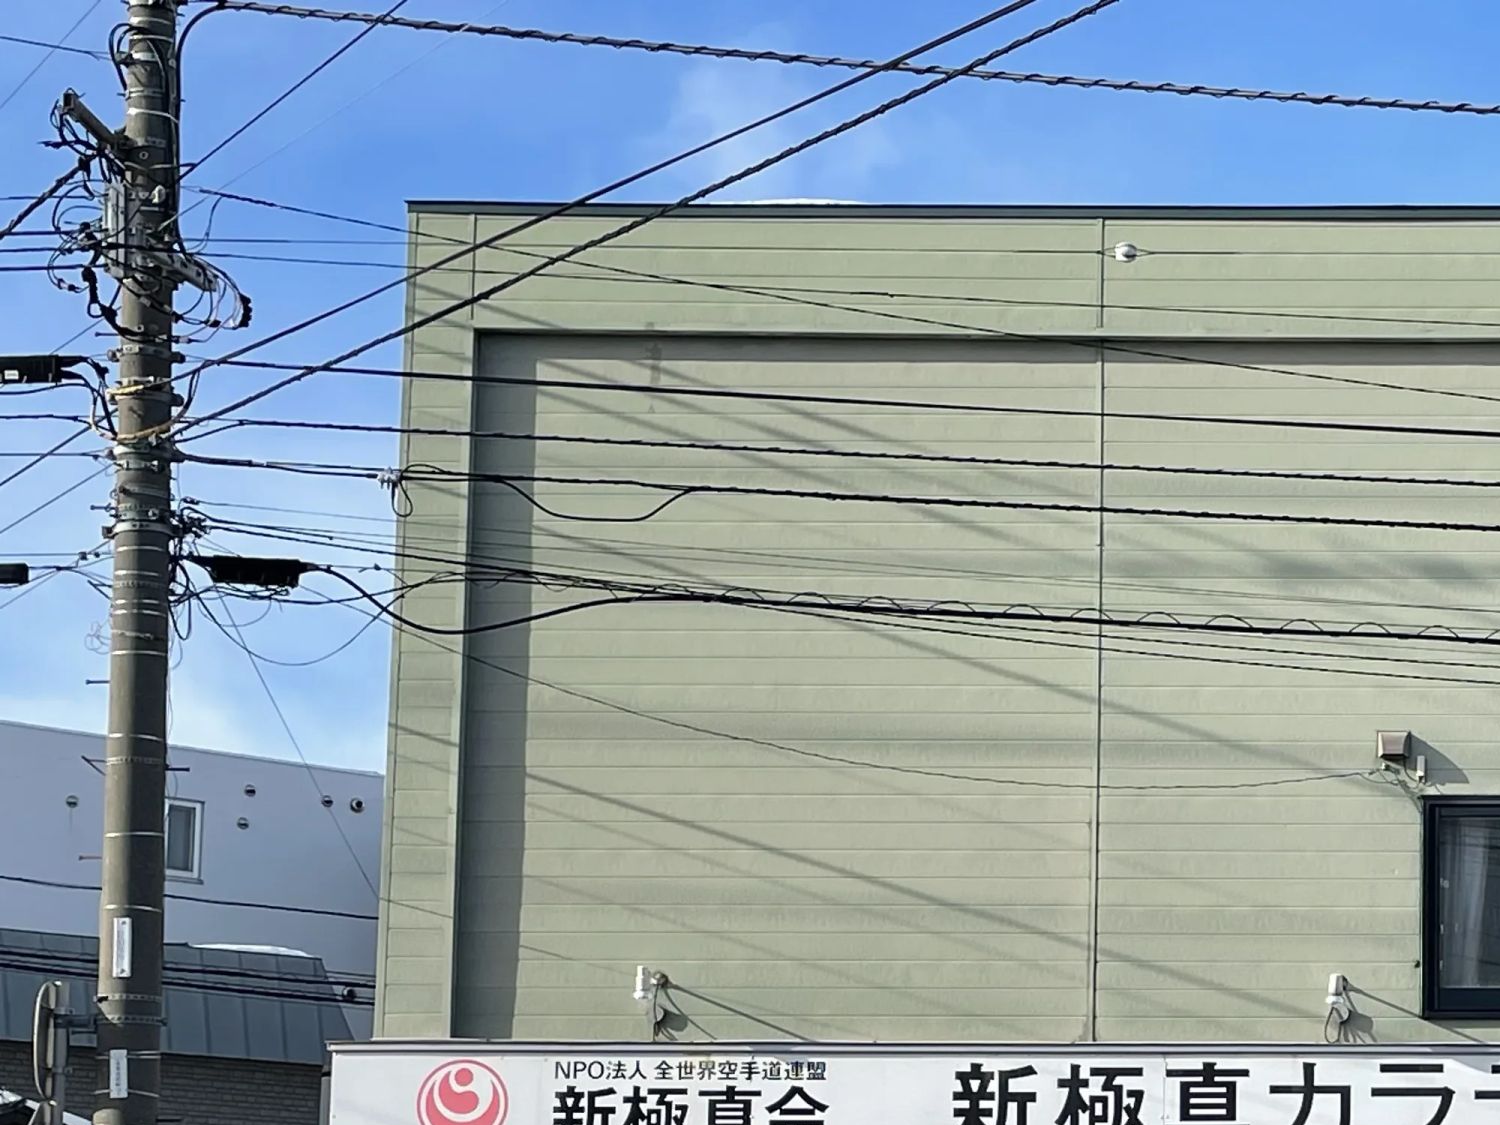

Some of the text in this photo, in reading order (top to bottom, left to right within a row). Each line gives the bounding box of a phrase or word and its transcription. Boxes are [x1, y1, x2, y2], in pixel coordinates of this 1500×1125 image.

[554, 1060, 827, 1081] NPO法人 全世界空手道連盟
